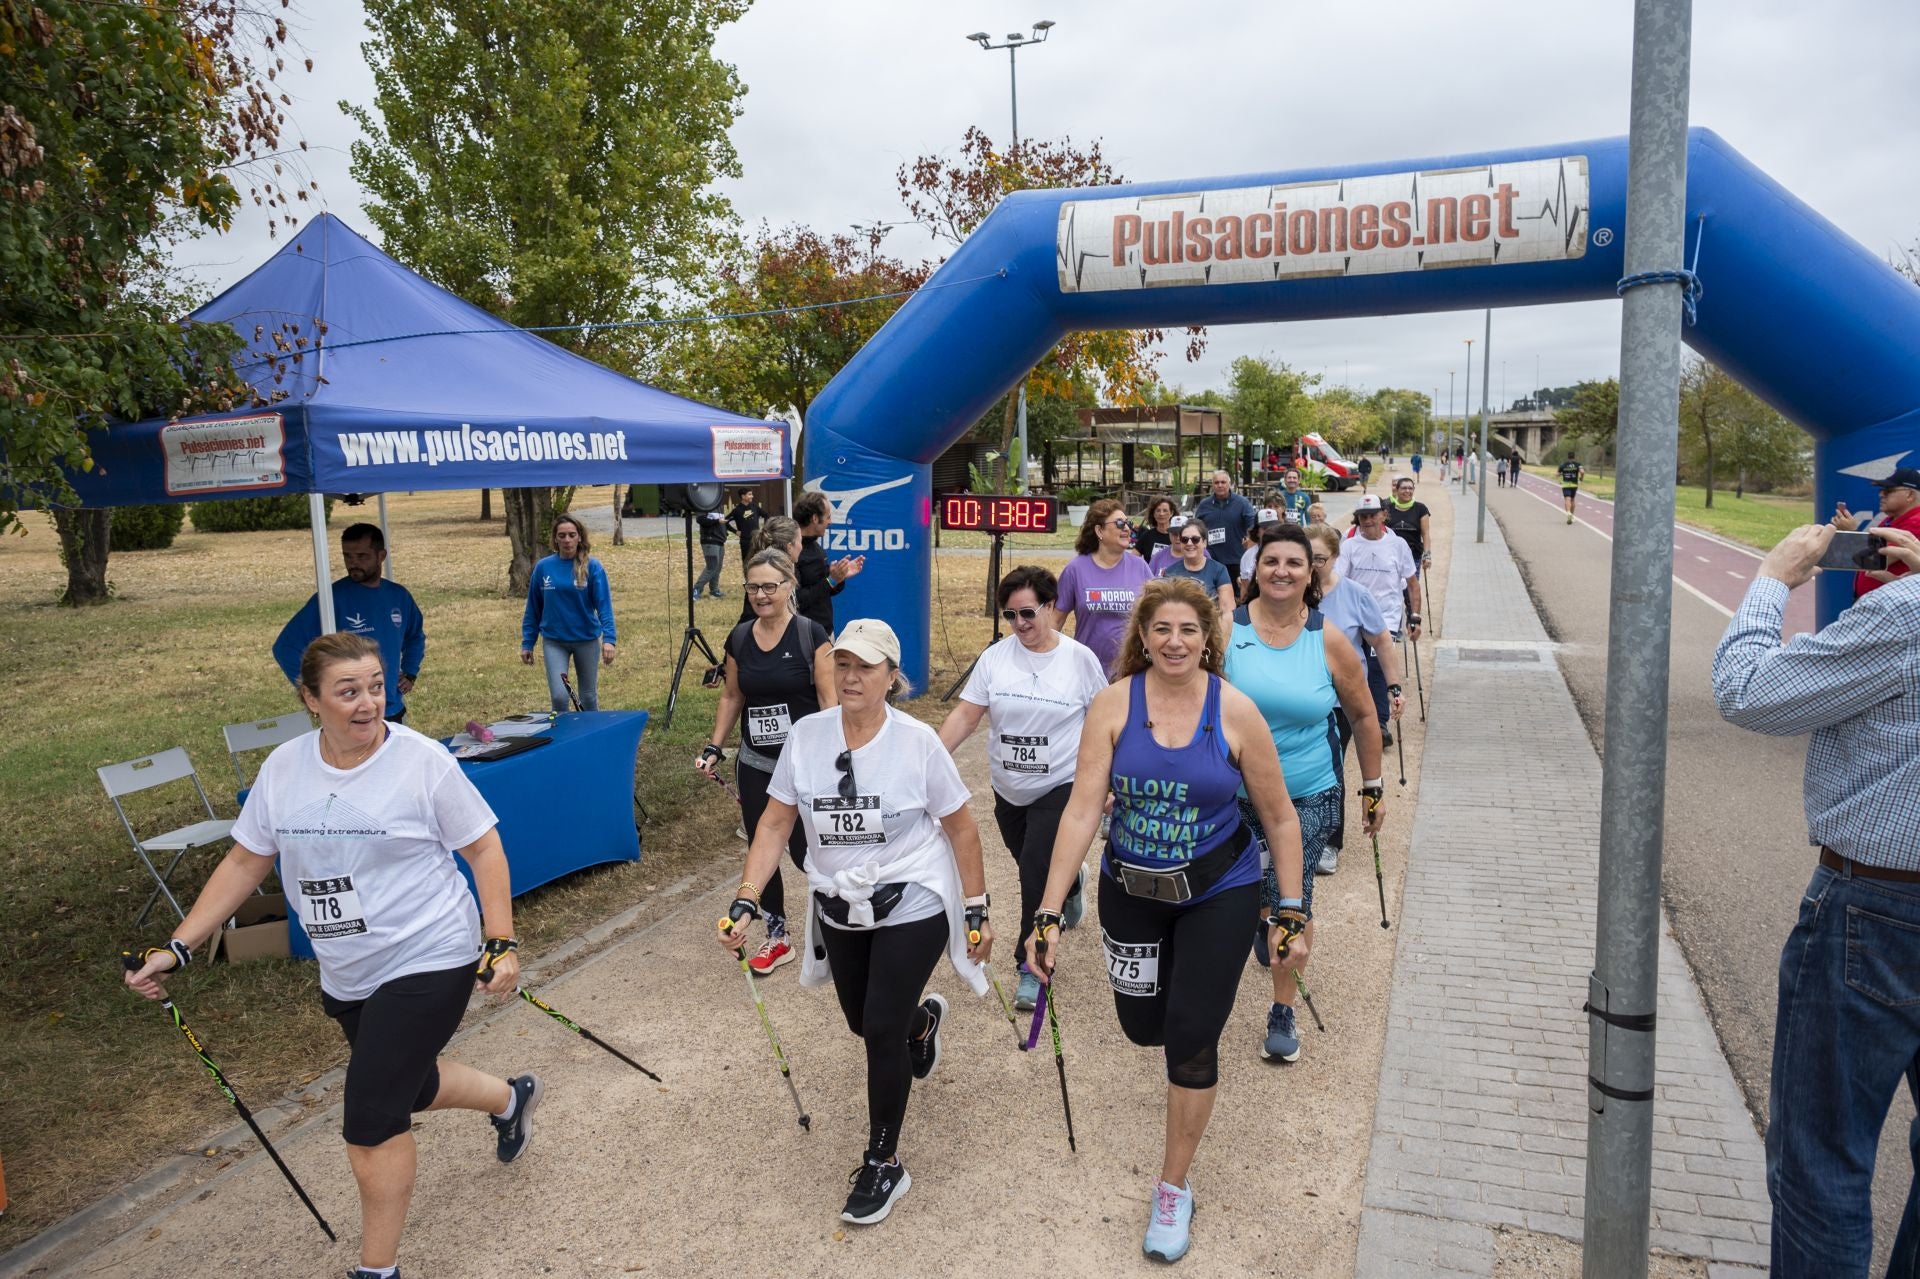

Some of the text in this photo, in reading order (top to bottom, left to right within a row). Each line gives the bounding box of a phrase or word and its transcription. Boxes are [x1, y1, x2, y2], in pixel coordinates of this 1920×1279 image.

[1112, 182, 1520, 268] Pulsaciones.net
[180, 435, 266, 455] Pulsaciones.net
[337, 423, 628, 467] www.pulsaciones.net
[724, 440, 772, 451] Pulsaciones.net
[947, 499, 1047, 528] 00:13:82
[818, 528, 905, 551] IZUNO
[1100, 590, 1135, 602] NORDIC
[1086, 602, 1134, 611] WALKING
[1011, 693, 1033, 701] Walking
[1033, 696, 1070, 707] Extremadura
[757, 718, 779, 733] 759
[1012, 746, 1037, 762] 784
[1131, 777, 1189, 802] LOVE
[291, 828, 325, 836] Walking
[327, 828, 387, 836] Extremadura
[830, 812, 866, 832] 782
[845, 833, 882, 841] EXTREMADURA
[1123, 834, 1197, 860] REPEAT
[310, 896, 342, 921] 778
[317, 924, 324, 932] DE
[324, 920, 362, 932] EXTREMADURA
[1110, 954, 1140, 979] 775
[1116, 977, 1152, 989] EXTREMADURA
[180, 1023, 203, 1053] VIPOLE
